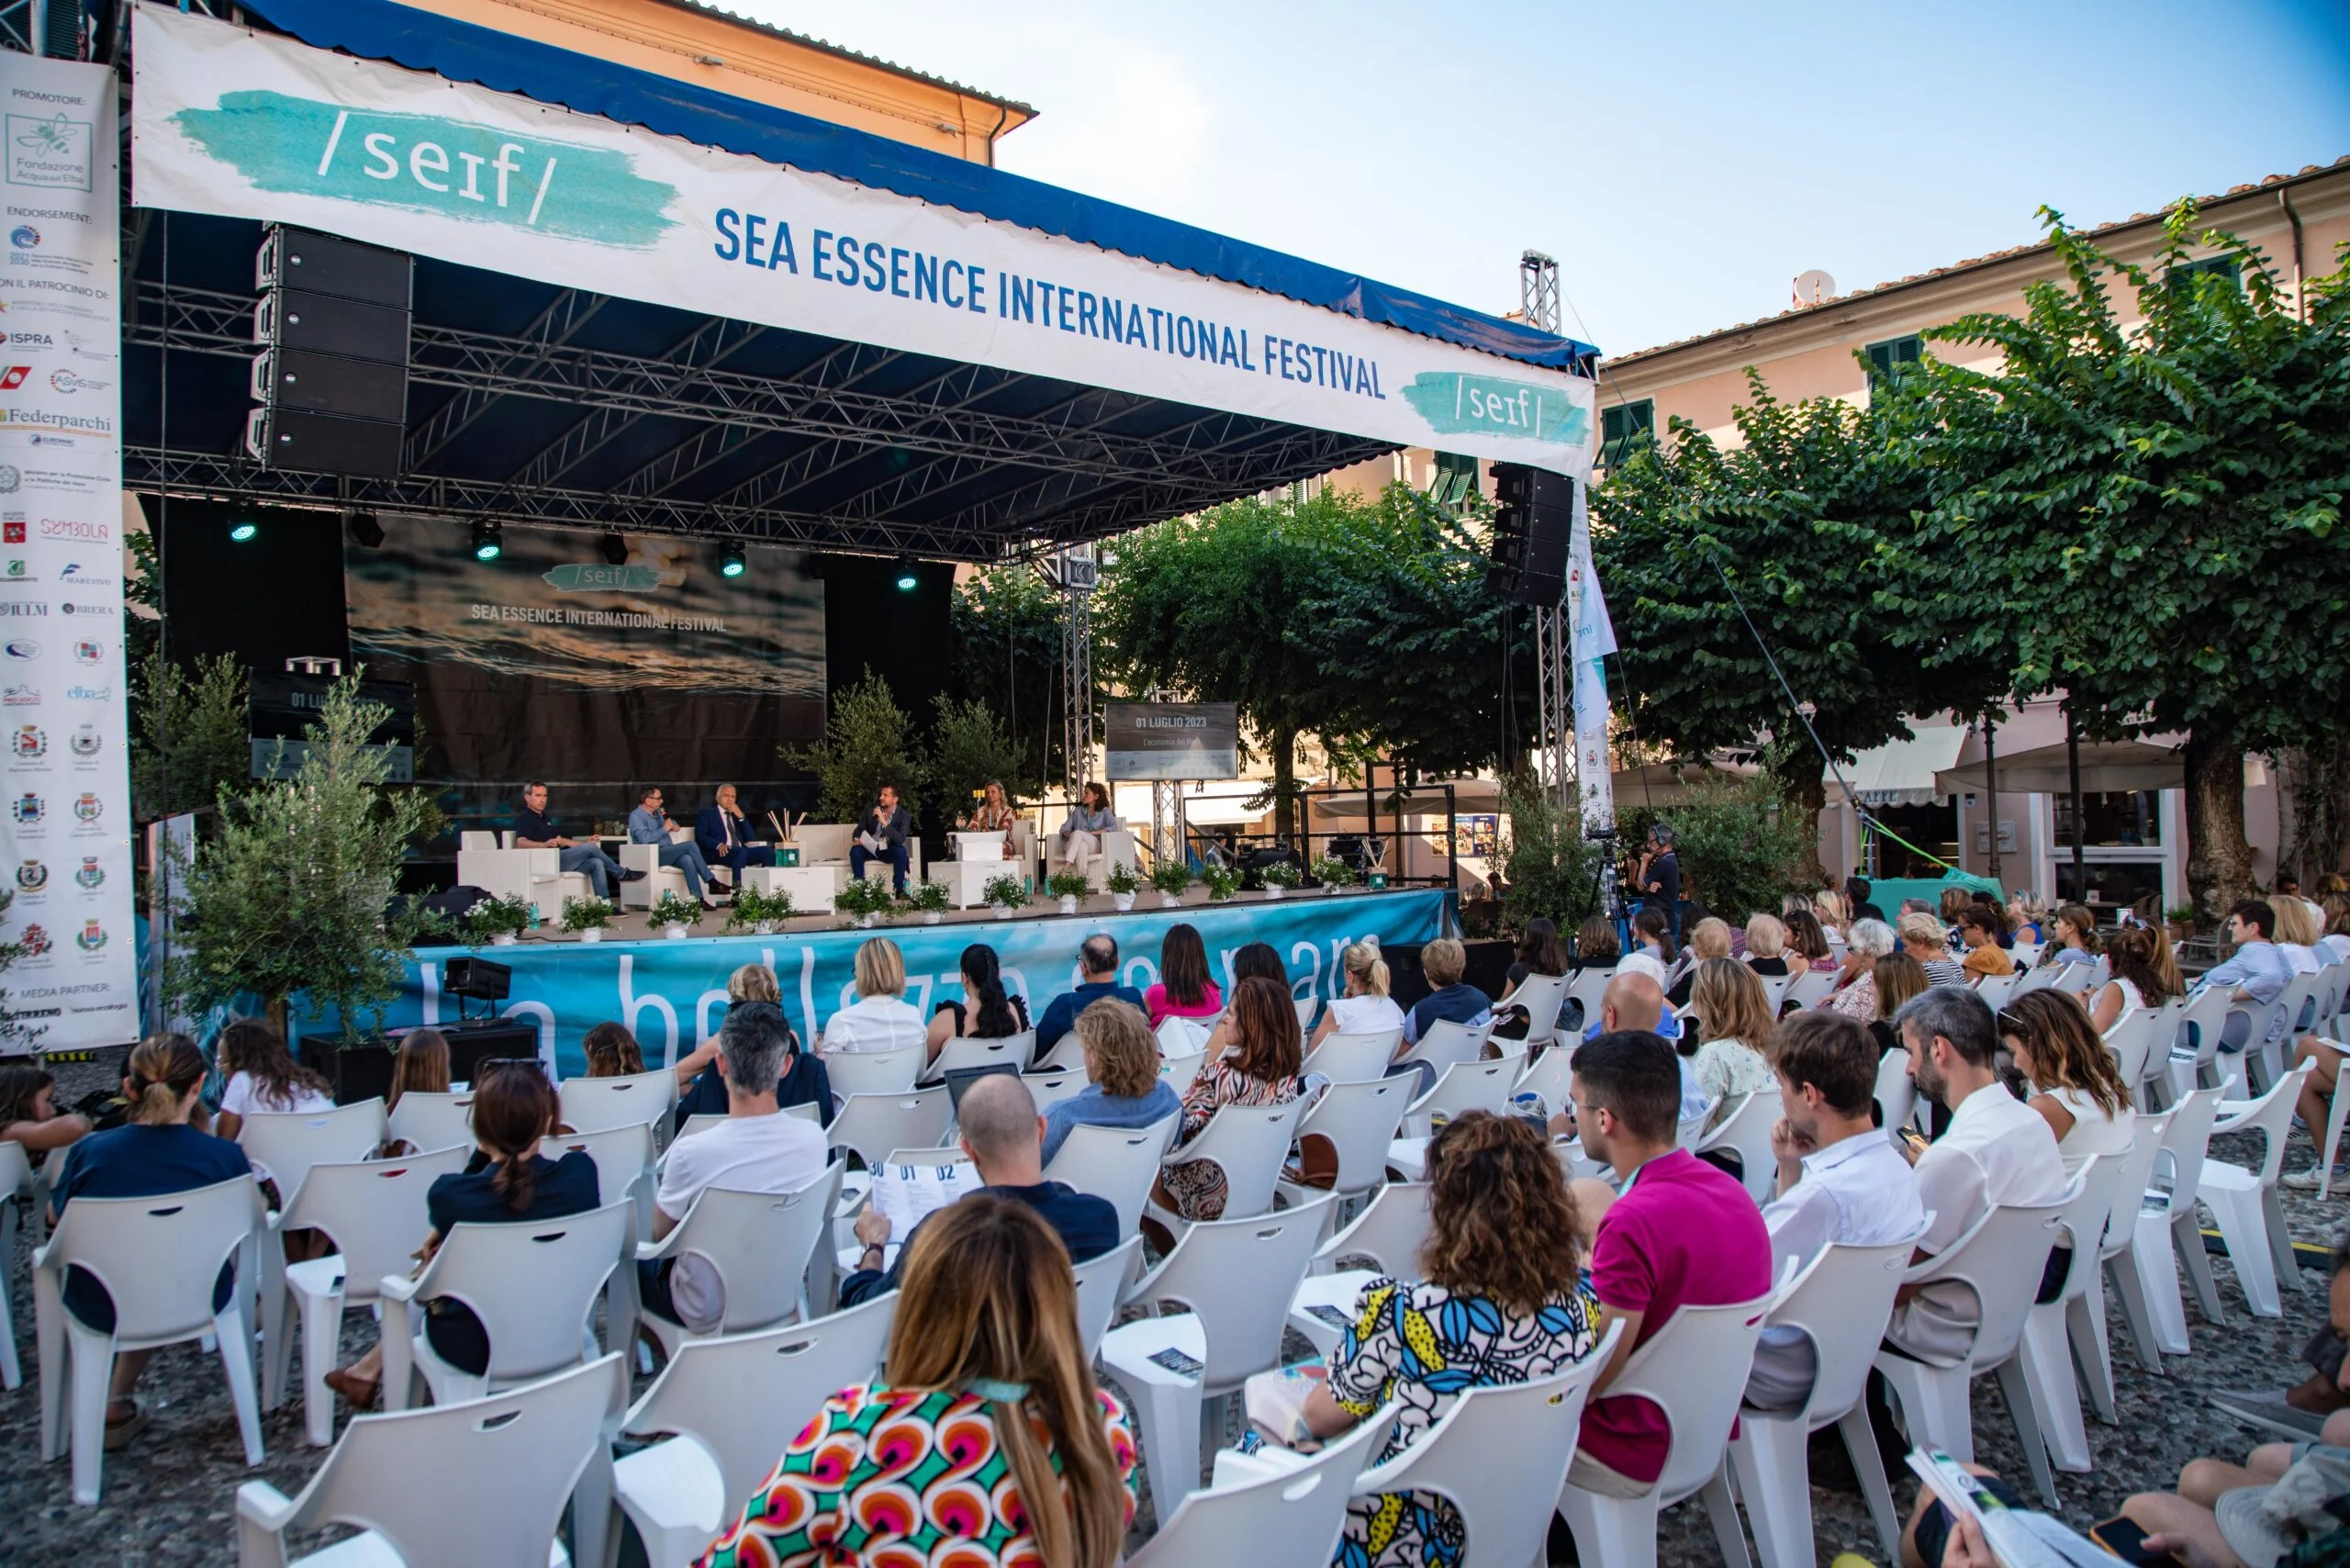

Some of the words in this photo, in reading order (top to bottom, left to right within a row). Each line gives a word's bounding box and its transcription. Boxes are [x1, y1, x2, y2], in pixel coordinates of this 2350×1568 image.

[13, 88, 86, 106] PROMOTORE:
[17, 158, 84, 173] Fondazione
[7, 206, 93, 225] ENDORSEMENT:
[0, 278, 14, 287] ON
[17, 278, 27, 288] IL
[28, 279, 94, 297] PATROCINIO
[95, 289, 110, 300] DI:
[714, 207, 799, 274] SEA
[812, 229, 987, 314] ESSENCE
[1000, 273, 1256, 372] INTERNATIONAL
[1264, 334, 1387, 400] FESTIVAL
[10, 333, 53, 345] ISPRA
[9, 409, 111, 431] Federparchi
[11, 604, 49, 617] IULM
[76, 605, 115, 615] BRERA
[472, 604, 499, 621] SEA
[502, 606, 563, 624] ESSENCE
[565, 610, 669, 630] INTERNATIONAL
[671, 615, 727, 633] FESTIVAL
[1136, 718, 1147, 728] 01
[1149, 717, 1183, 728] LUGLIO
[1185, 717, 1207, 728] 2023
[20, 988, 57, 999] MEDIA
[900, 1165, 916, 1181] 01
[936, 1164, 956, 1182] 02
